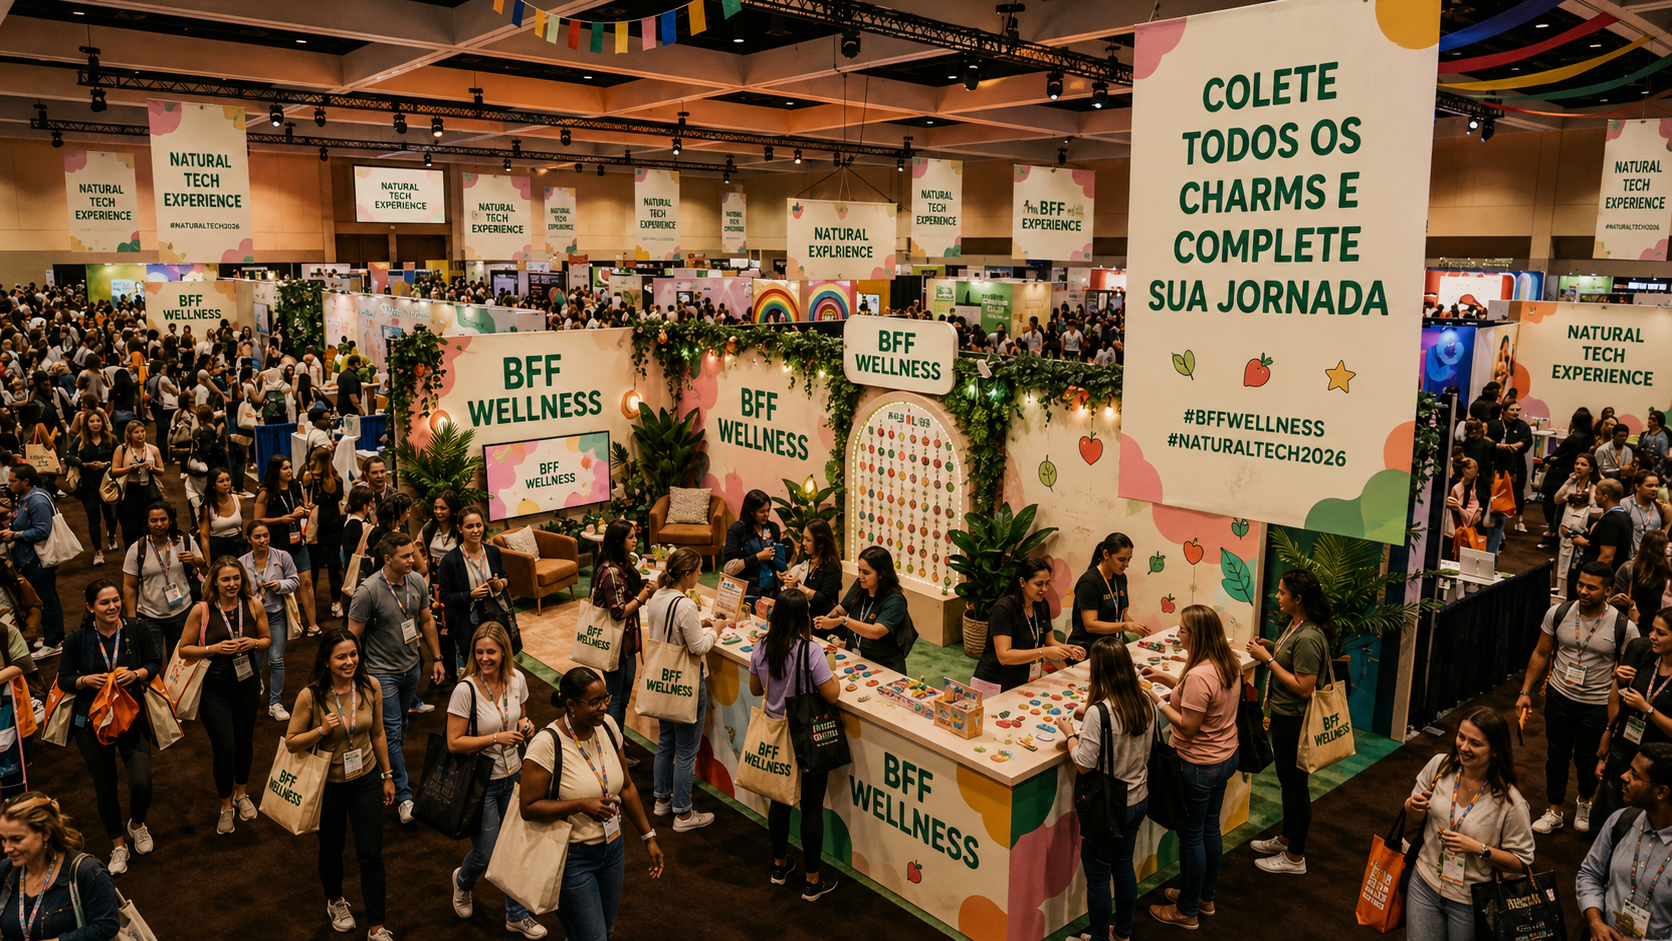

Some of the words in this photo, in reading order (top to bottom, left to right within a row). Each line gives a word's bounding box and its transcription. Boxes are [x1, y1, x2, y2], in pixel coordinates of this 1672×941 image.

[1203, 62, 1338, 112] COLETE
[1182, 122, 1298, 165] TODOS
[1311, 117, 1361, 156] OS
[170, 152, 231, 168] NATURAL
[1615, 160, 1662, 173] NATURAL
[184, 173, 219, 188] TECH
[381, 181, 420, 192] NATURAL
[1622, 178, 1651, 192] TECH
[78, 183, 125, 195] NATURAL
[388, 191, 412, 201] TECH
[920, 189, 954, 201] NATURAL
[1180, 174, 1326, 214] CHARMS
[1338, 172, 1360, 208] E
[88, 196, 116, 208] TECH
[164, 193, 241, 208] EXPERIENCE
[374, 200, 427, 211] EXPERIENCE
[478, 202, 516, 213] NATURAL
[927, 202, 947, 213] TECH
[1040, 201, 1065, 216] BFF
[1605, 196, 1666, 210] EXPERIENCE
[74, 209, 132, 221] EXPERIENCE
[485, 212, 509, 223] TECH
[471, 223, 524, 235] EXPERIENCE
[1023, 218, 1081, 231] EXPERIENCE
[815, 227, 868, 241] NATURAL
[809, 245, 872, 258] EXPLRIENCE
[1174, 226, 1361, 263] COMPLETE
[178, 294, 203, 308] BFF
[1149, 280, 1208, 312] SUA
[1217, 280, 1388, 316] JORNADA
[162, 308, 222, 321] WELLNESS
[879, 330, 916, 354] BFF
[1568, 325, 1644, 343] NATURAL
[1583, 346, 1625, 363] TECH
[503, 354, 561, 390] BFF
[855, 354, 941, 380] WELLNESS
[1552, 365, 1653, 386] EXPERIENCE
[467, 390, 602, 427] WELLNESS
[741, 388, 778, 421] BFF
[1183, 409, 1325, 437] #BFFWELLNESS
[718, 418, 809, 461] WELLNESS
[1168, 433, 1347, 467] #NATURALTECH2026
[540, 461, 559, 475] BFF
[525, 473, 576, 489] WELLNESS
[586, 624, 604, 638] BFF
[661, 668, 682, 682] BFF
[646, 679, 692, 697] WELLNESS
[1323, 713, 1340, 731] BFF
[758, 741, 779, 757] BFF
[744, 750, 791, 777] WELLNESS
[279, 769, 297, 786] BFF
[884, 751, 933, 803] BFF
[268, 778, 302, 806] WELLNESS
[849, 774, 980, 870] WELLNESS
